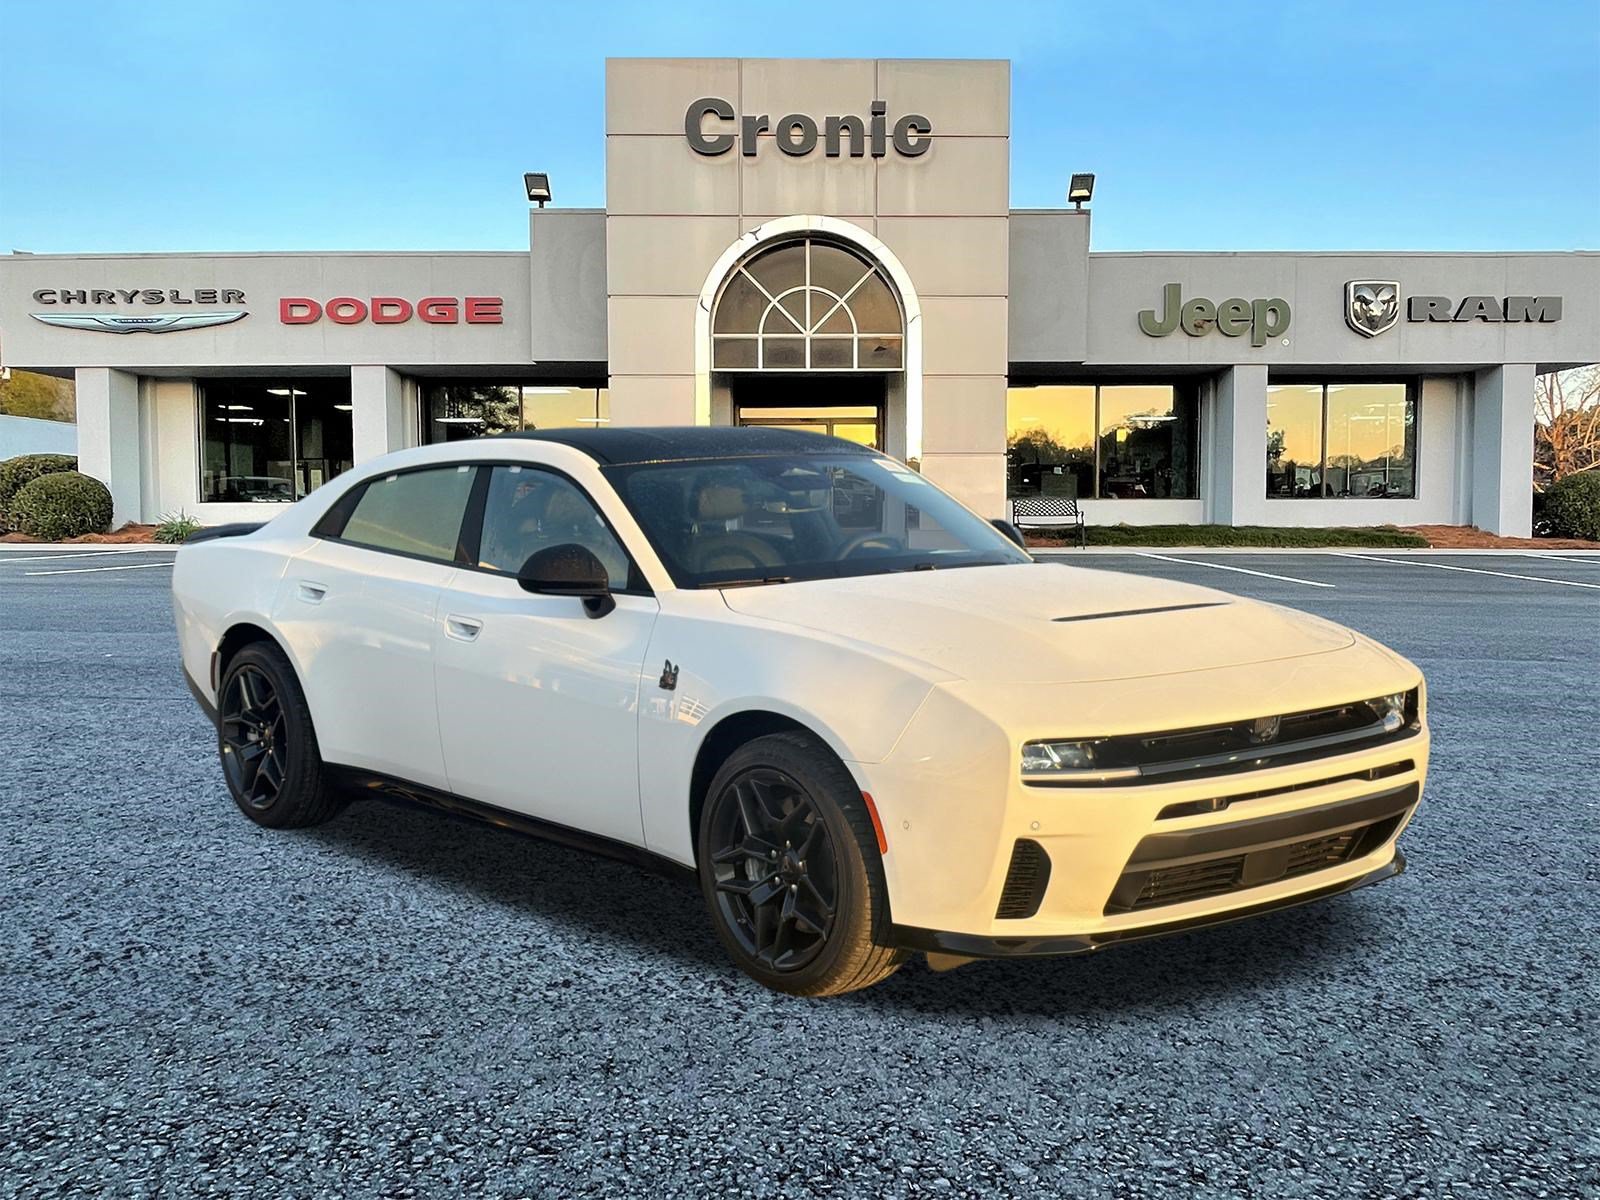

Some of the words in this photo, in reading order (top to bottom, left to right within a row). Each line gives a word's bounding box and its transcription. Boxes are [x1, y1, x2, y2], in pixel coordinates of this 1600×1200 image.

[685, 97, 932, 157] Cronic
[33, 289, 246, 304] CHRYSLER
[1407, 296, 1563, 322] RAM
[279, 297, 503, 324] DODGE
[1138, 283, 1291, 347] Jeep
